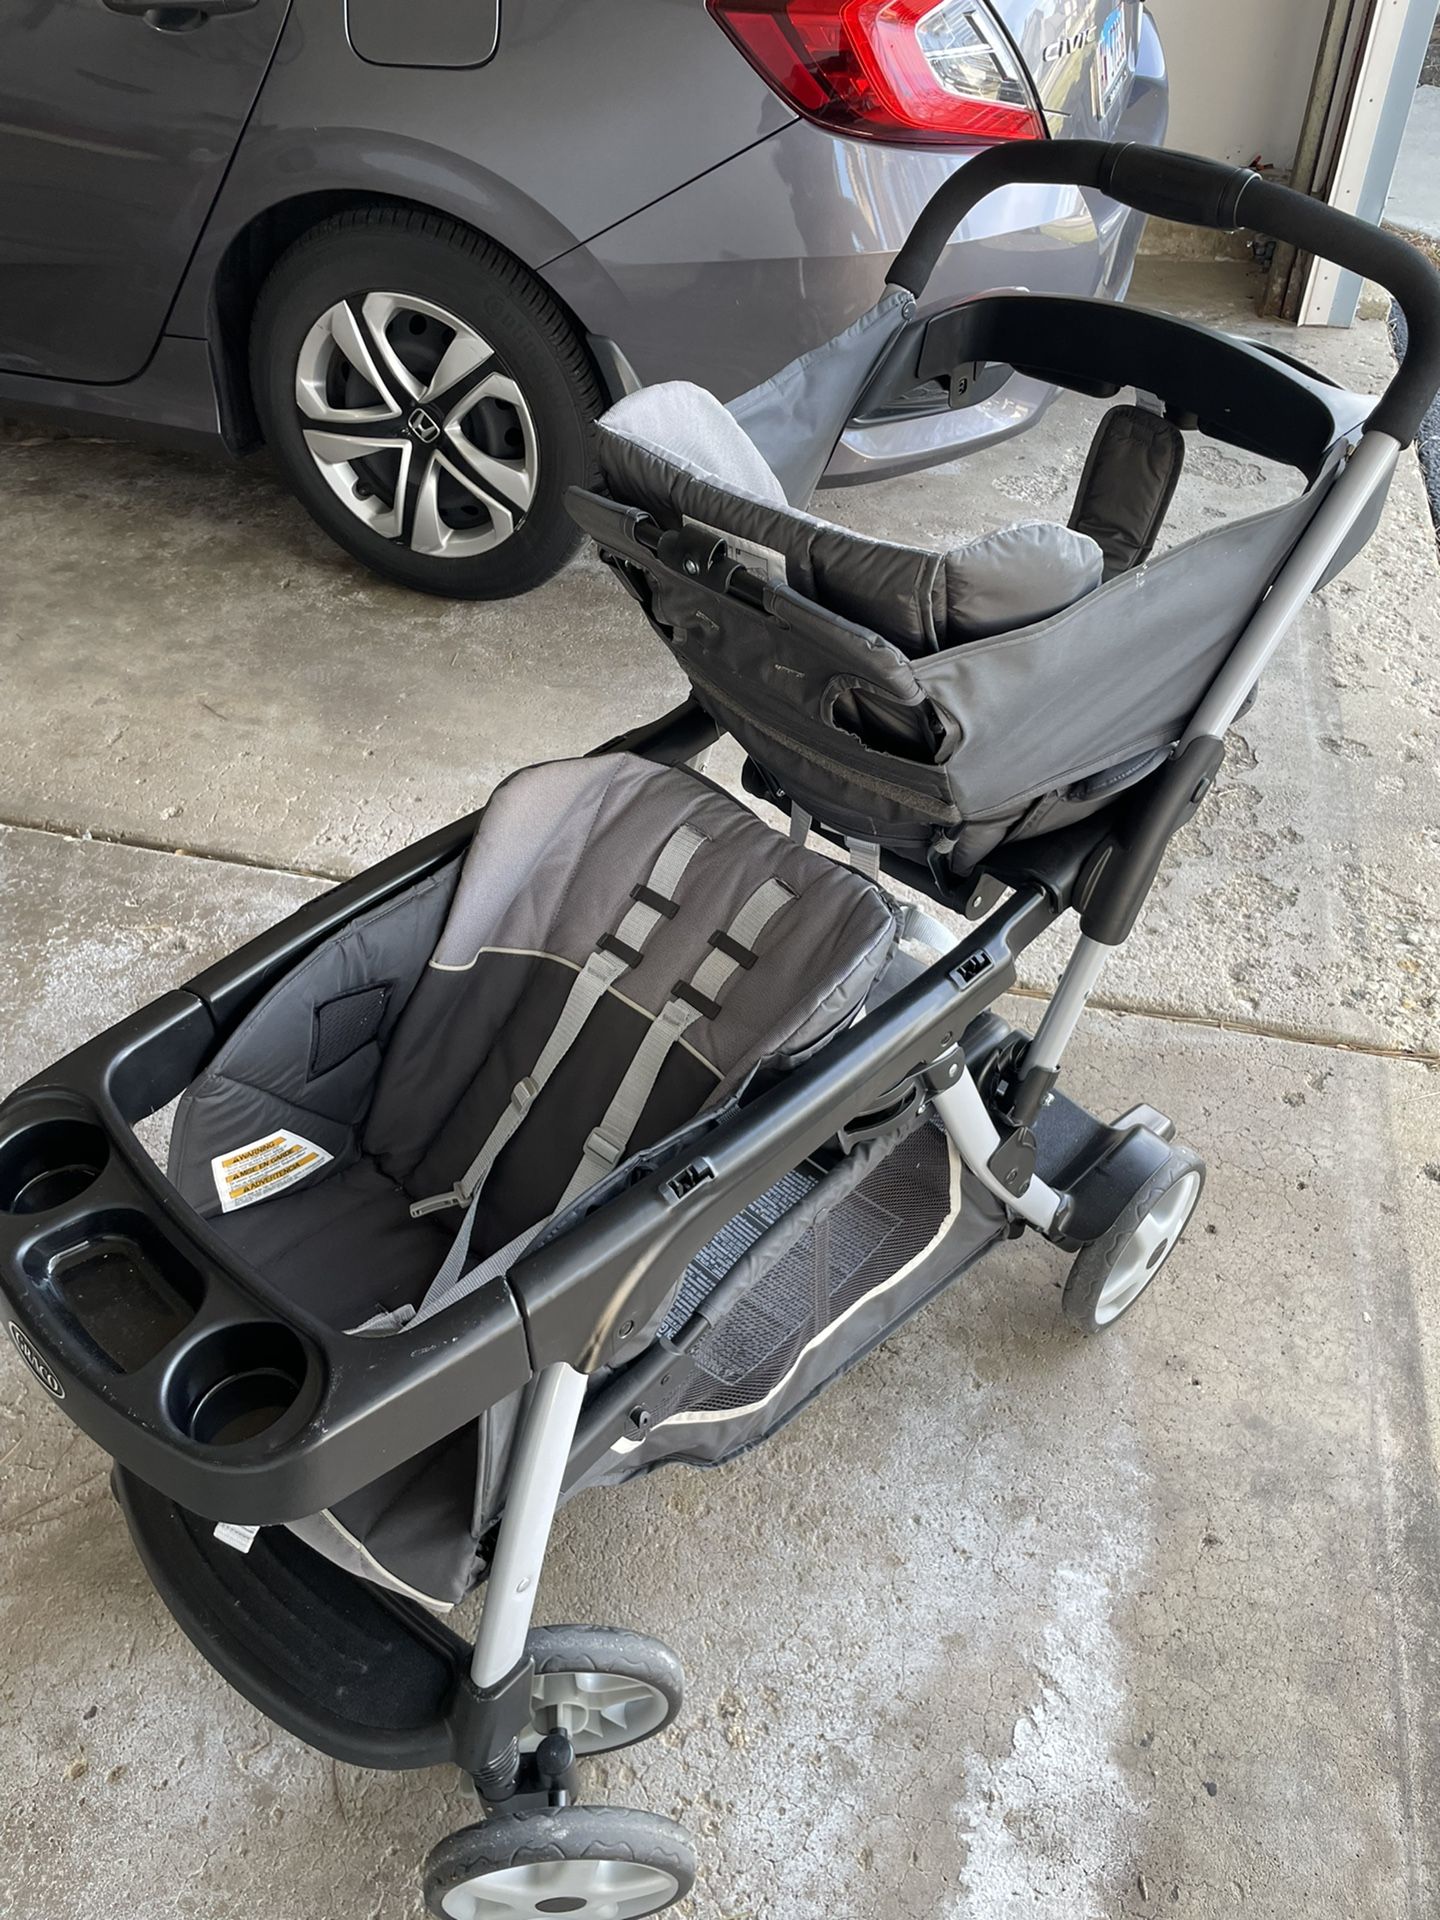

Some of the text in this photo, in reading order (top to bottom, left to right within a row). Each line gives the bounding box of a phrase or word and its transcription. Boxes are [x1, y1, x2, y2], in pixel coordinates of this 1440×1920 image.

[1042, 25, 1097, 62] CIVIC
[239, 1141, 275, 1160] WARNING
[239, 1164, 258, 1178] MISE
[258, 1160, 269, 1170] EN
[270, 1148, 293, 1164] GARDE
[250, 1161, 300, 1190] ADVERTENCIA
[15, 1331, 59, 1392] GRACO
